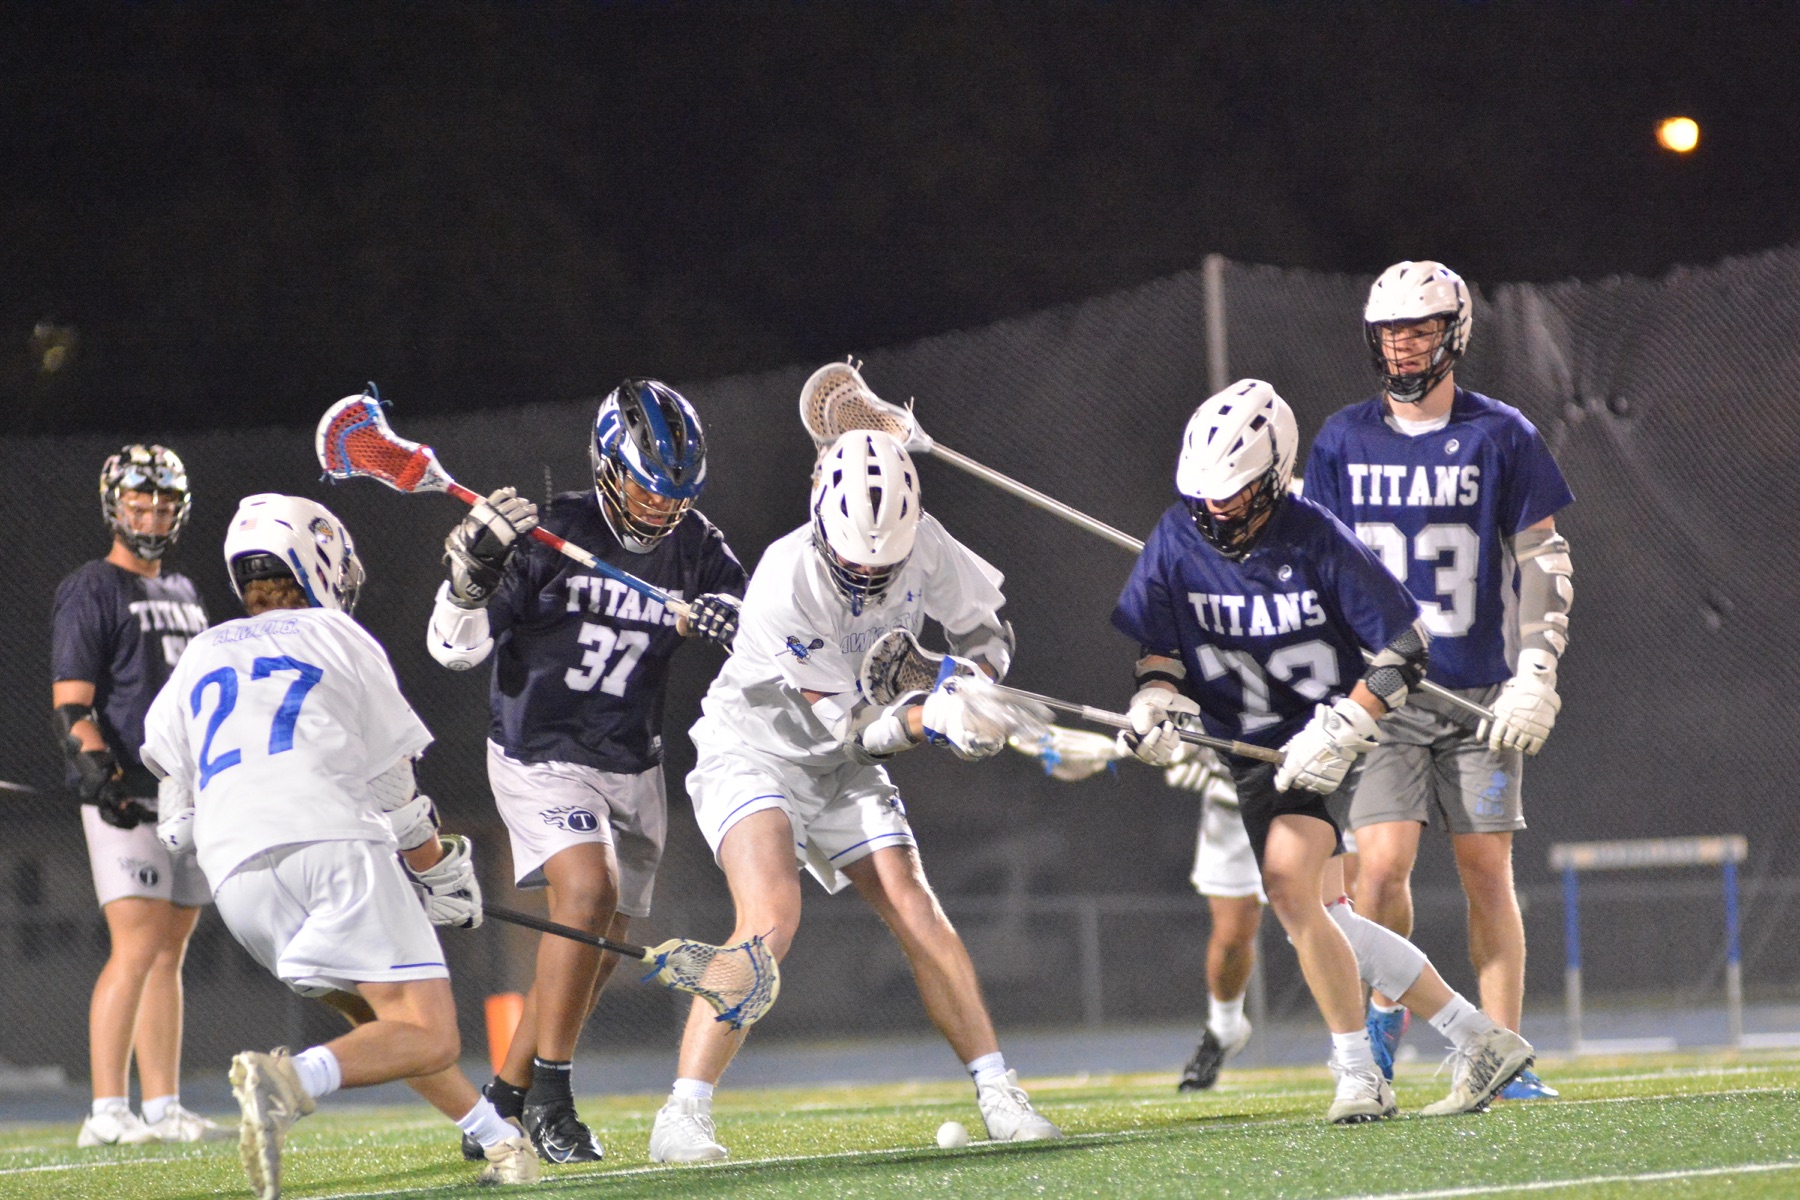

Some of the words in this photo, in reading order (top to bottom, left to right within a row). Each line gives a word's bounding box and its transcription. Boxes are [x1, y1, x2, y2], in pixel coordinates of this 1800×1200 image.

[1347, 464, 1481, 507] TITANS
[1187, 589, 1328, 637] TITANS
[563, 621, 651, 698] 37
[189, 654, 324, 792] 27
[572, 813, 592, 830] T
